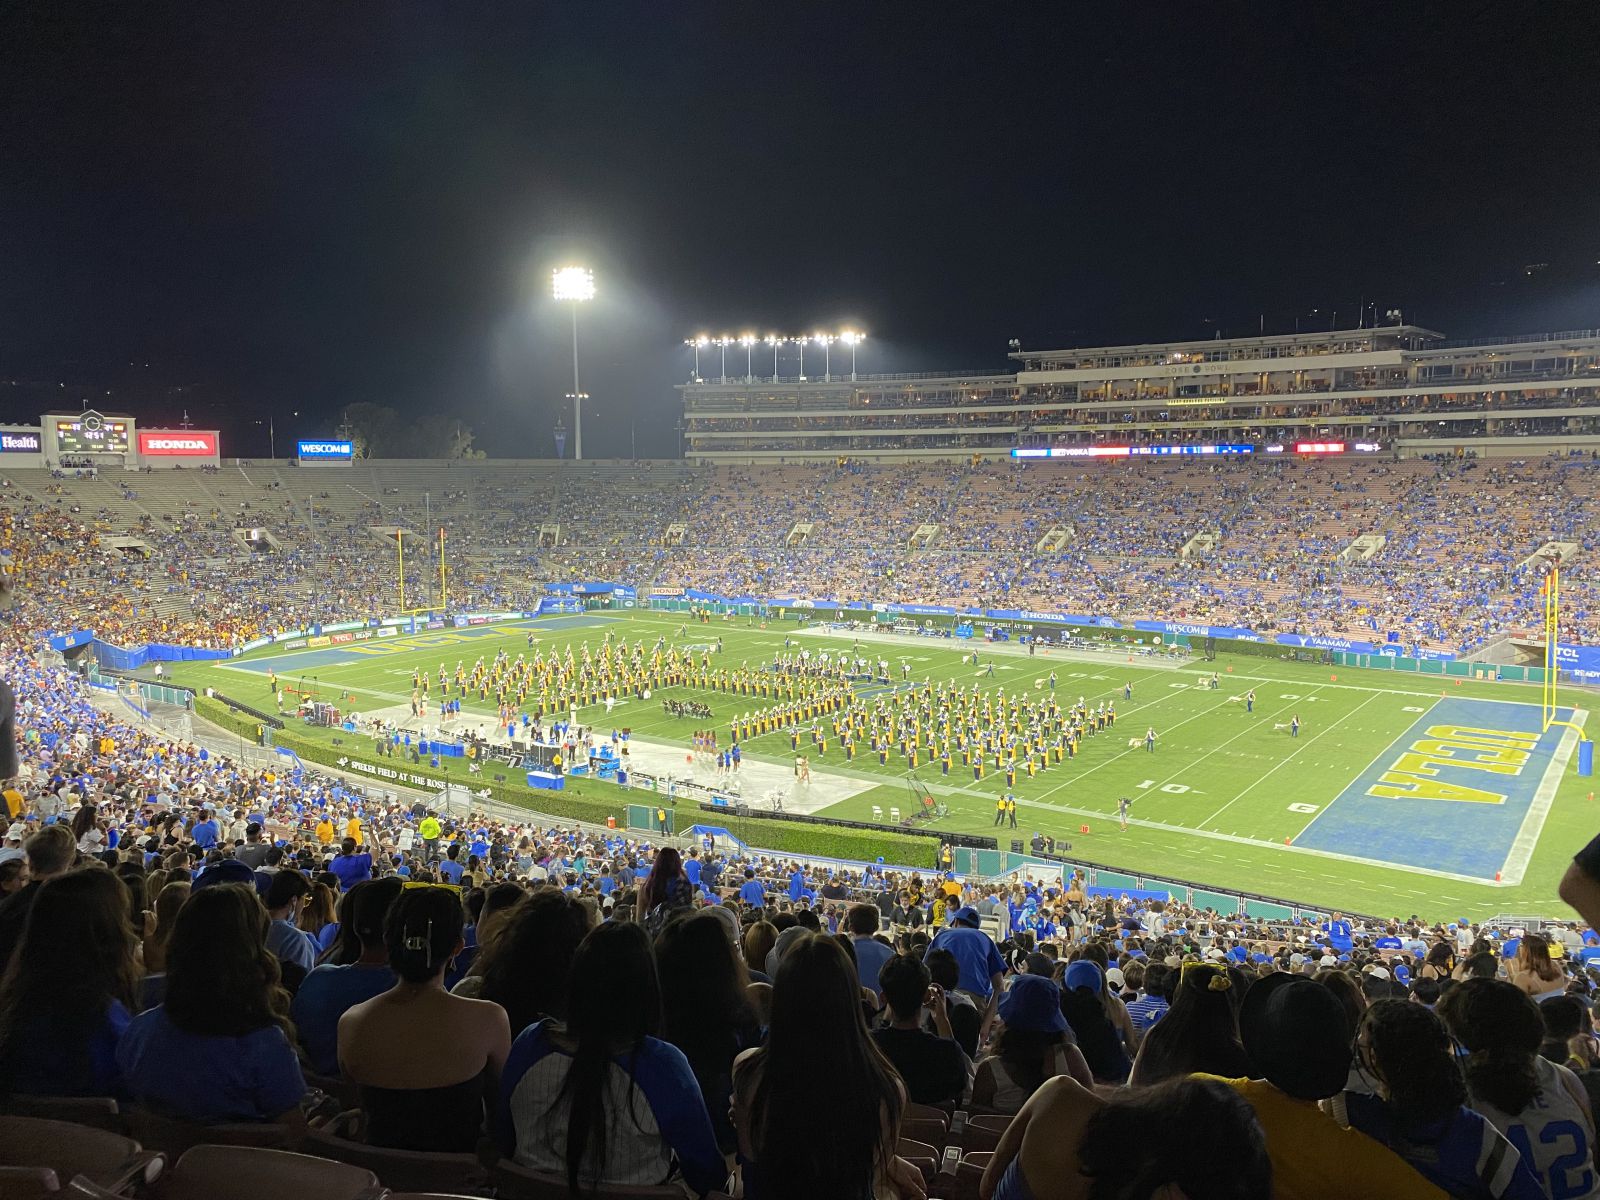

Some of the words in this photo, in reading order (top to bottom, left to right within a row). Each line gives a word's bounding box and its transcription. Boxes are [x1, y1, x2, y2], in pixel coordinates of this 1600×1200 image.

[1, 436, 38, 449] Health
[147, 439, 209, 449] HONDA
[301, 444, 340, 453] WESCOM
[653, 587, 684, 595] HONDA
[1165, 623, 1200, 634] WESCOM
[335, 634, 351, 642] TCL
[1556, 647, 1580, 658] TCL
[1364, 724, 1542, 805] UCLA
[351, 761, 377, 775] SPIEKER
[377, 767, 397, 779] FIELD
[398, 772, 408, 782] AT
[409, 774, 426, 786] THE
[427, 778, 447, 790] ROSE
[1136, 779, 1191, 794] 10
[1286, 802, 1321, 814] G
